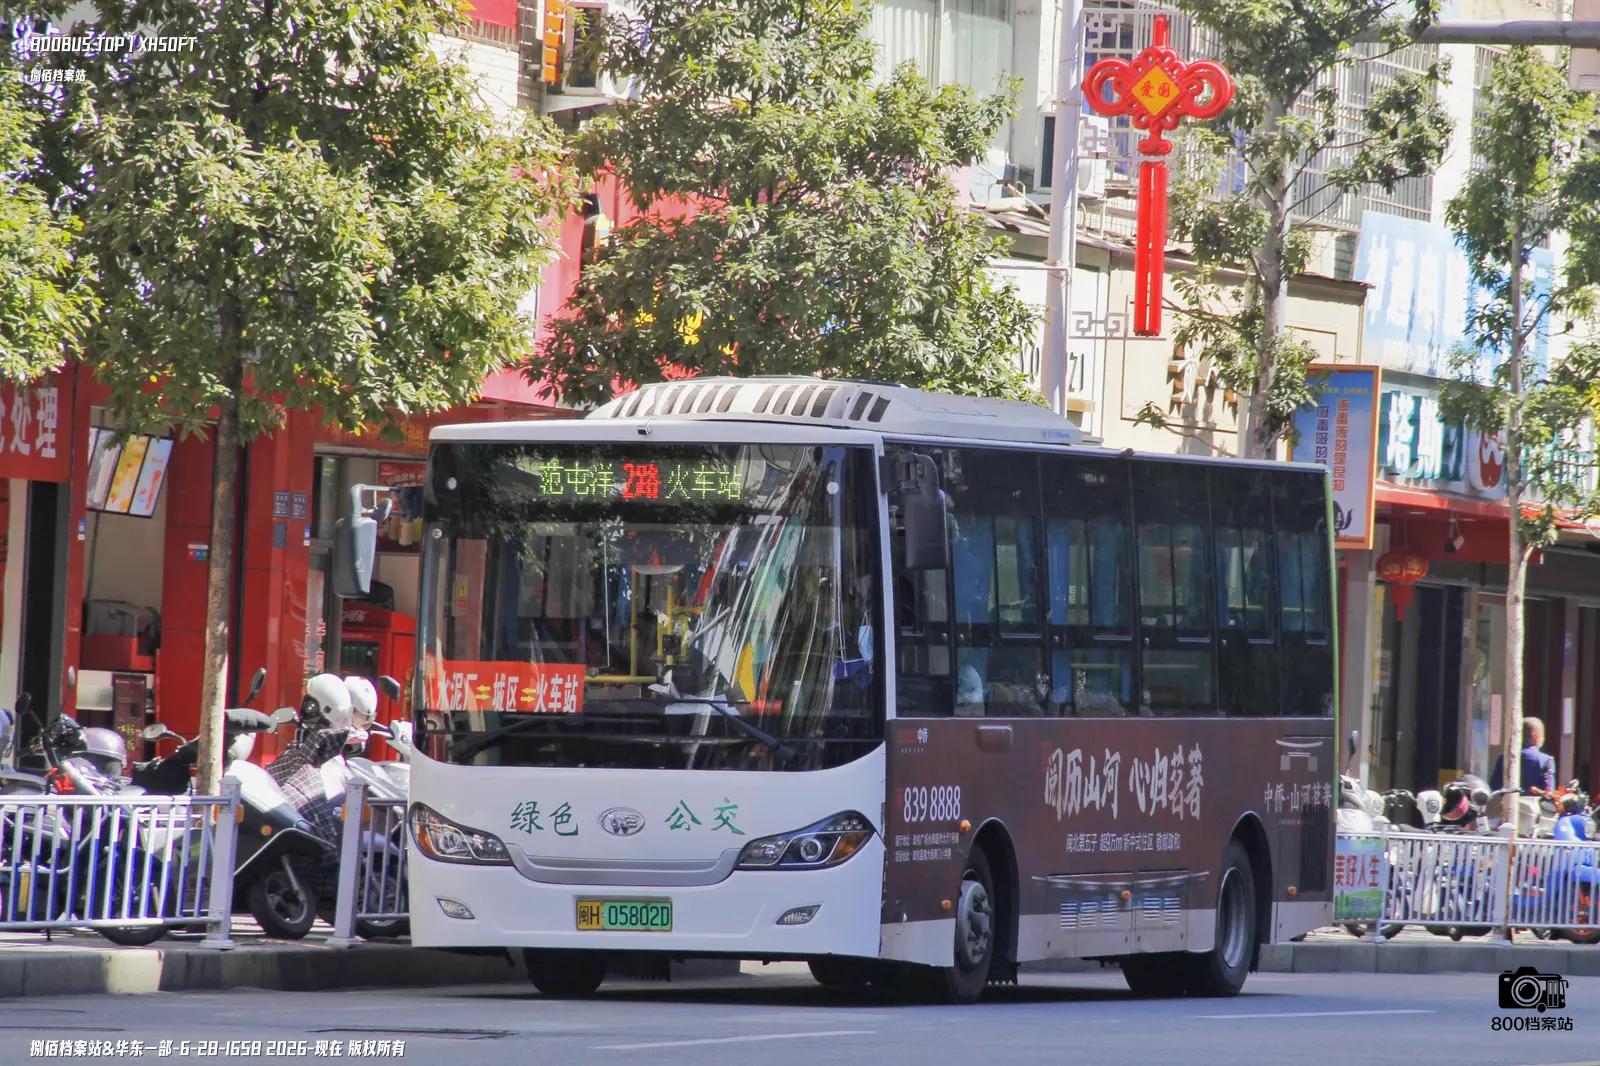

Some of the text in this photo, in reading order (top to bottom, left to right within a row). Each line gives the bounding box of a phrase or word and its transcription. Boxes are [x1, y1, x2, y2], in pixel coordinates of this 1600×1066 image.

[1141, 81, 1171, 99] 爱国
[0, 380, 59, 459] 处理
[1332, 398, 1350, 492] 贩毒贩的是良知
[539, 461, 743, 499] 范屯洋 2路 火车站
[436, 671, 579, 713] 水泥厂 城区 火车站
[904, 787, 928, 822] 839
[930, 785, 961, 820] 8888
[1045, 748, 1121, 821] 阅历山河
[510, 797, 746, 836] 绿色 公交
[608, 905, 670, 926] 05802D
